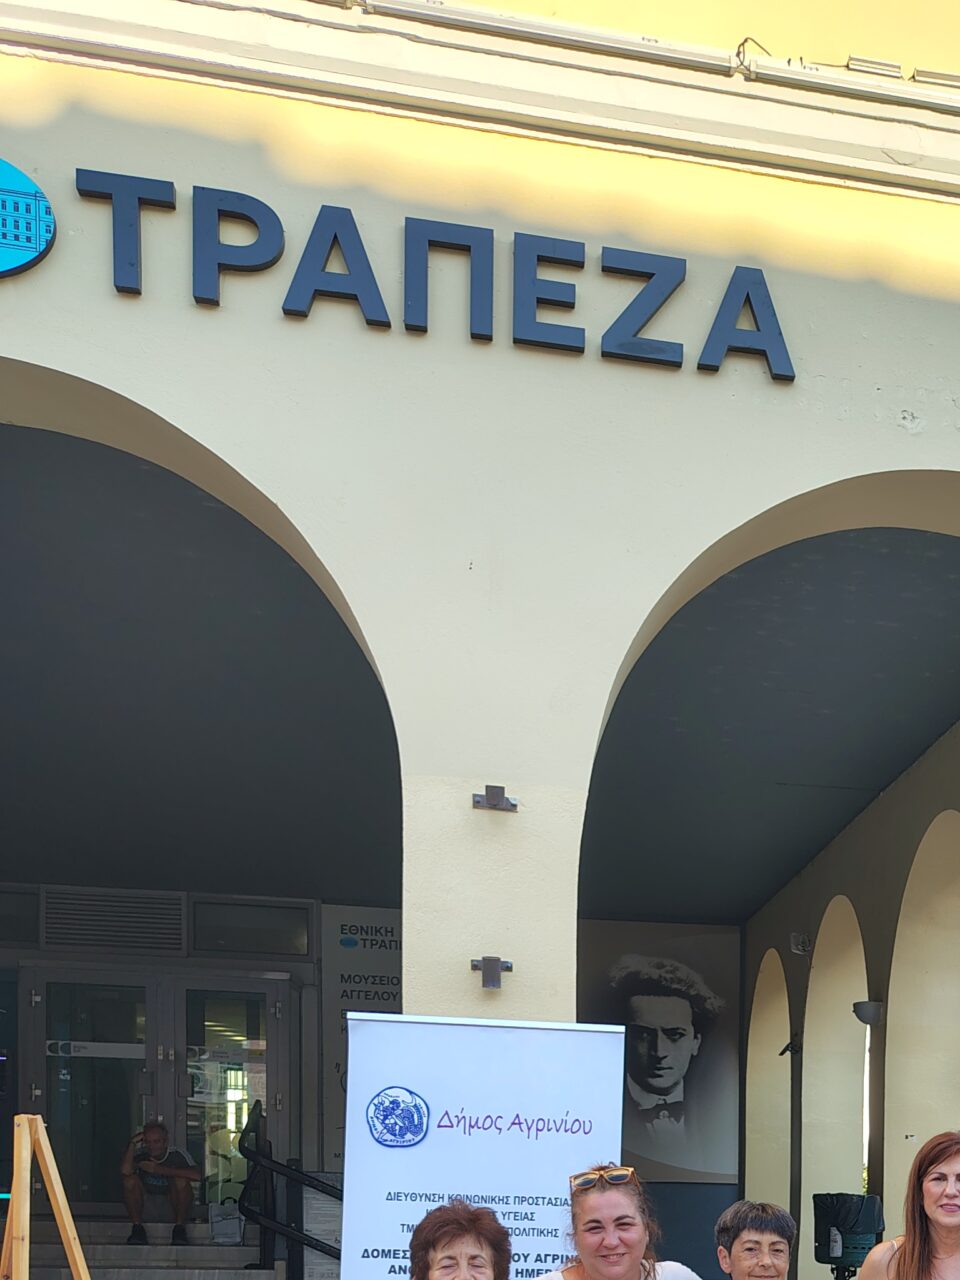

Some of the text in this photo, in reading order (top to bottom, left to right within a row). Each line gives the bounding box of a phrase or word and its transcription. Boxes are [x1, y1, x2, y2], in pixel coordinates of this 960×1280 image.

[75, 167, 796, 382] ΤΡΑΠΕΖΑ
[340, 924, 394, 938] ΕΘΝΙΚΗ
[361, 938, 402, 951] ΤΡΑΠ
[340, 974, 400, 986] ΜΟΥΣΕΙΟ
[340, 989, 399, 1001] ΑΓΓΕΛΟΥ
[437, 1107, 503, 1136] Δήμος
[507, 1110, 593, 1140] Αγρινίου
[386, 1191, 445, 1203] ΔΙΕΥΘΥΝΣΗ
[448, 1193, 511, 1206] ΚΟΙΝΩΝΙΚΗΣ
[501, 1211, 536, 1222] ΥΓΕΙΑΣ
[361, 1248, 410, 1260] ΔΟΜΕΣ
